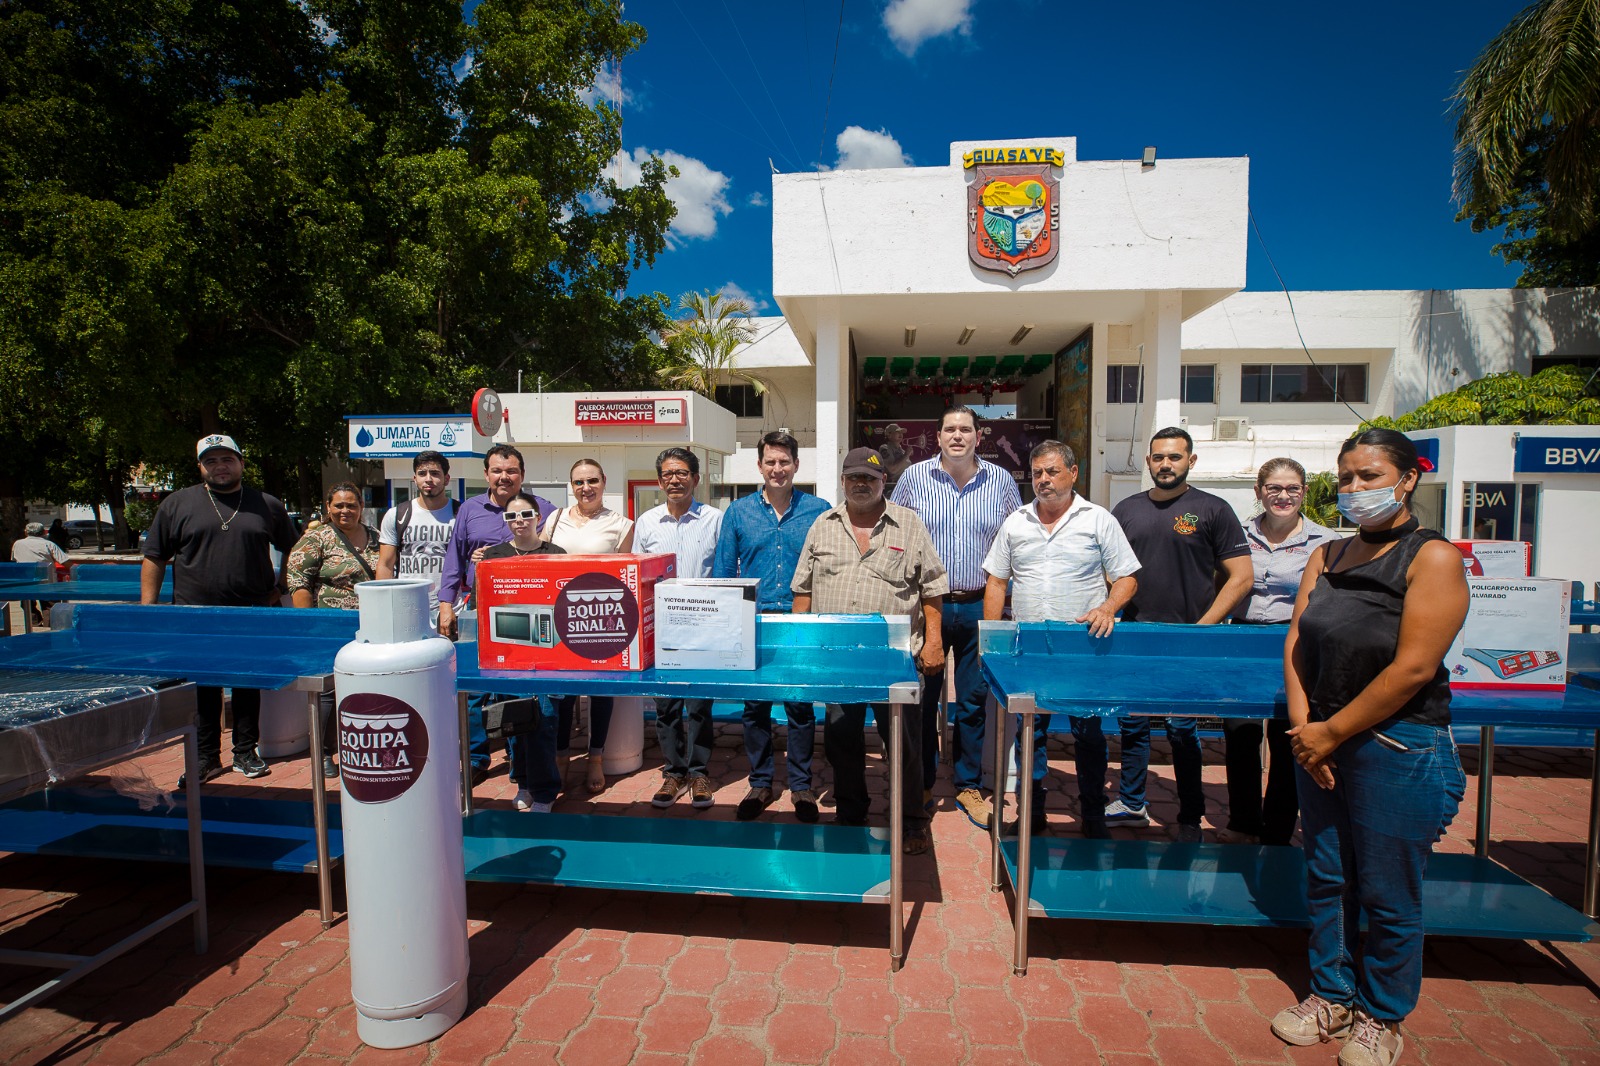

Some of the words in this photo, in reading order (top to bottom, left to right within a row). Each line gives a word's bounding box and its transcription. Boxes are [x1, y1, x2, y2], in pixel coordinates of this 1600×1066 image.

[973, 148, 1055, 163] GUASAVE
[606, 403, 653, 411] AUTOMATICOS
[590, 411, 653, 421] BANORTE
[375, 426, 430, 440] JUMAPAG
[404, 525, 453, 542] RIGINA
[400, 557, 443, 574] GRAPPL
[567, 602, 625, 619] EQUIPA
[341, 730, 409, 751] EQUIPA
